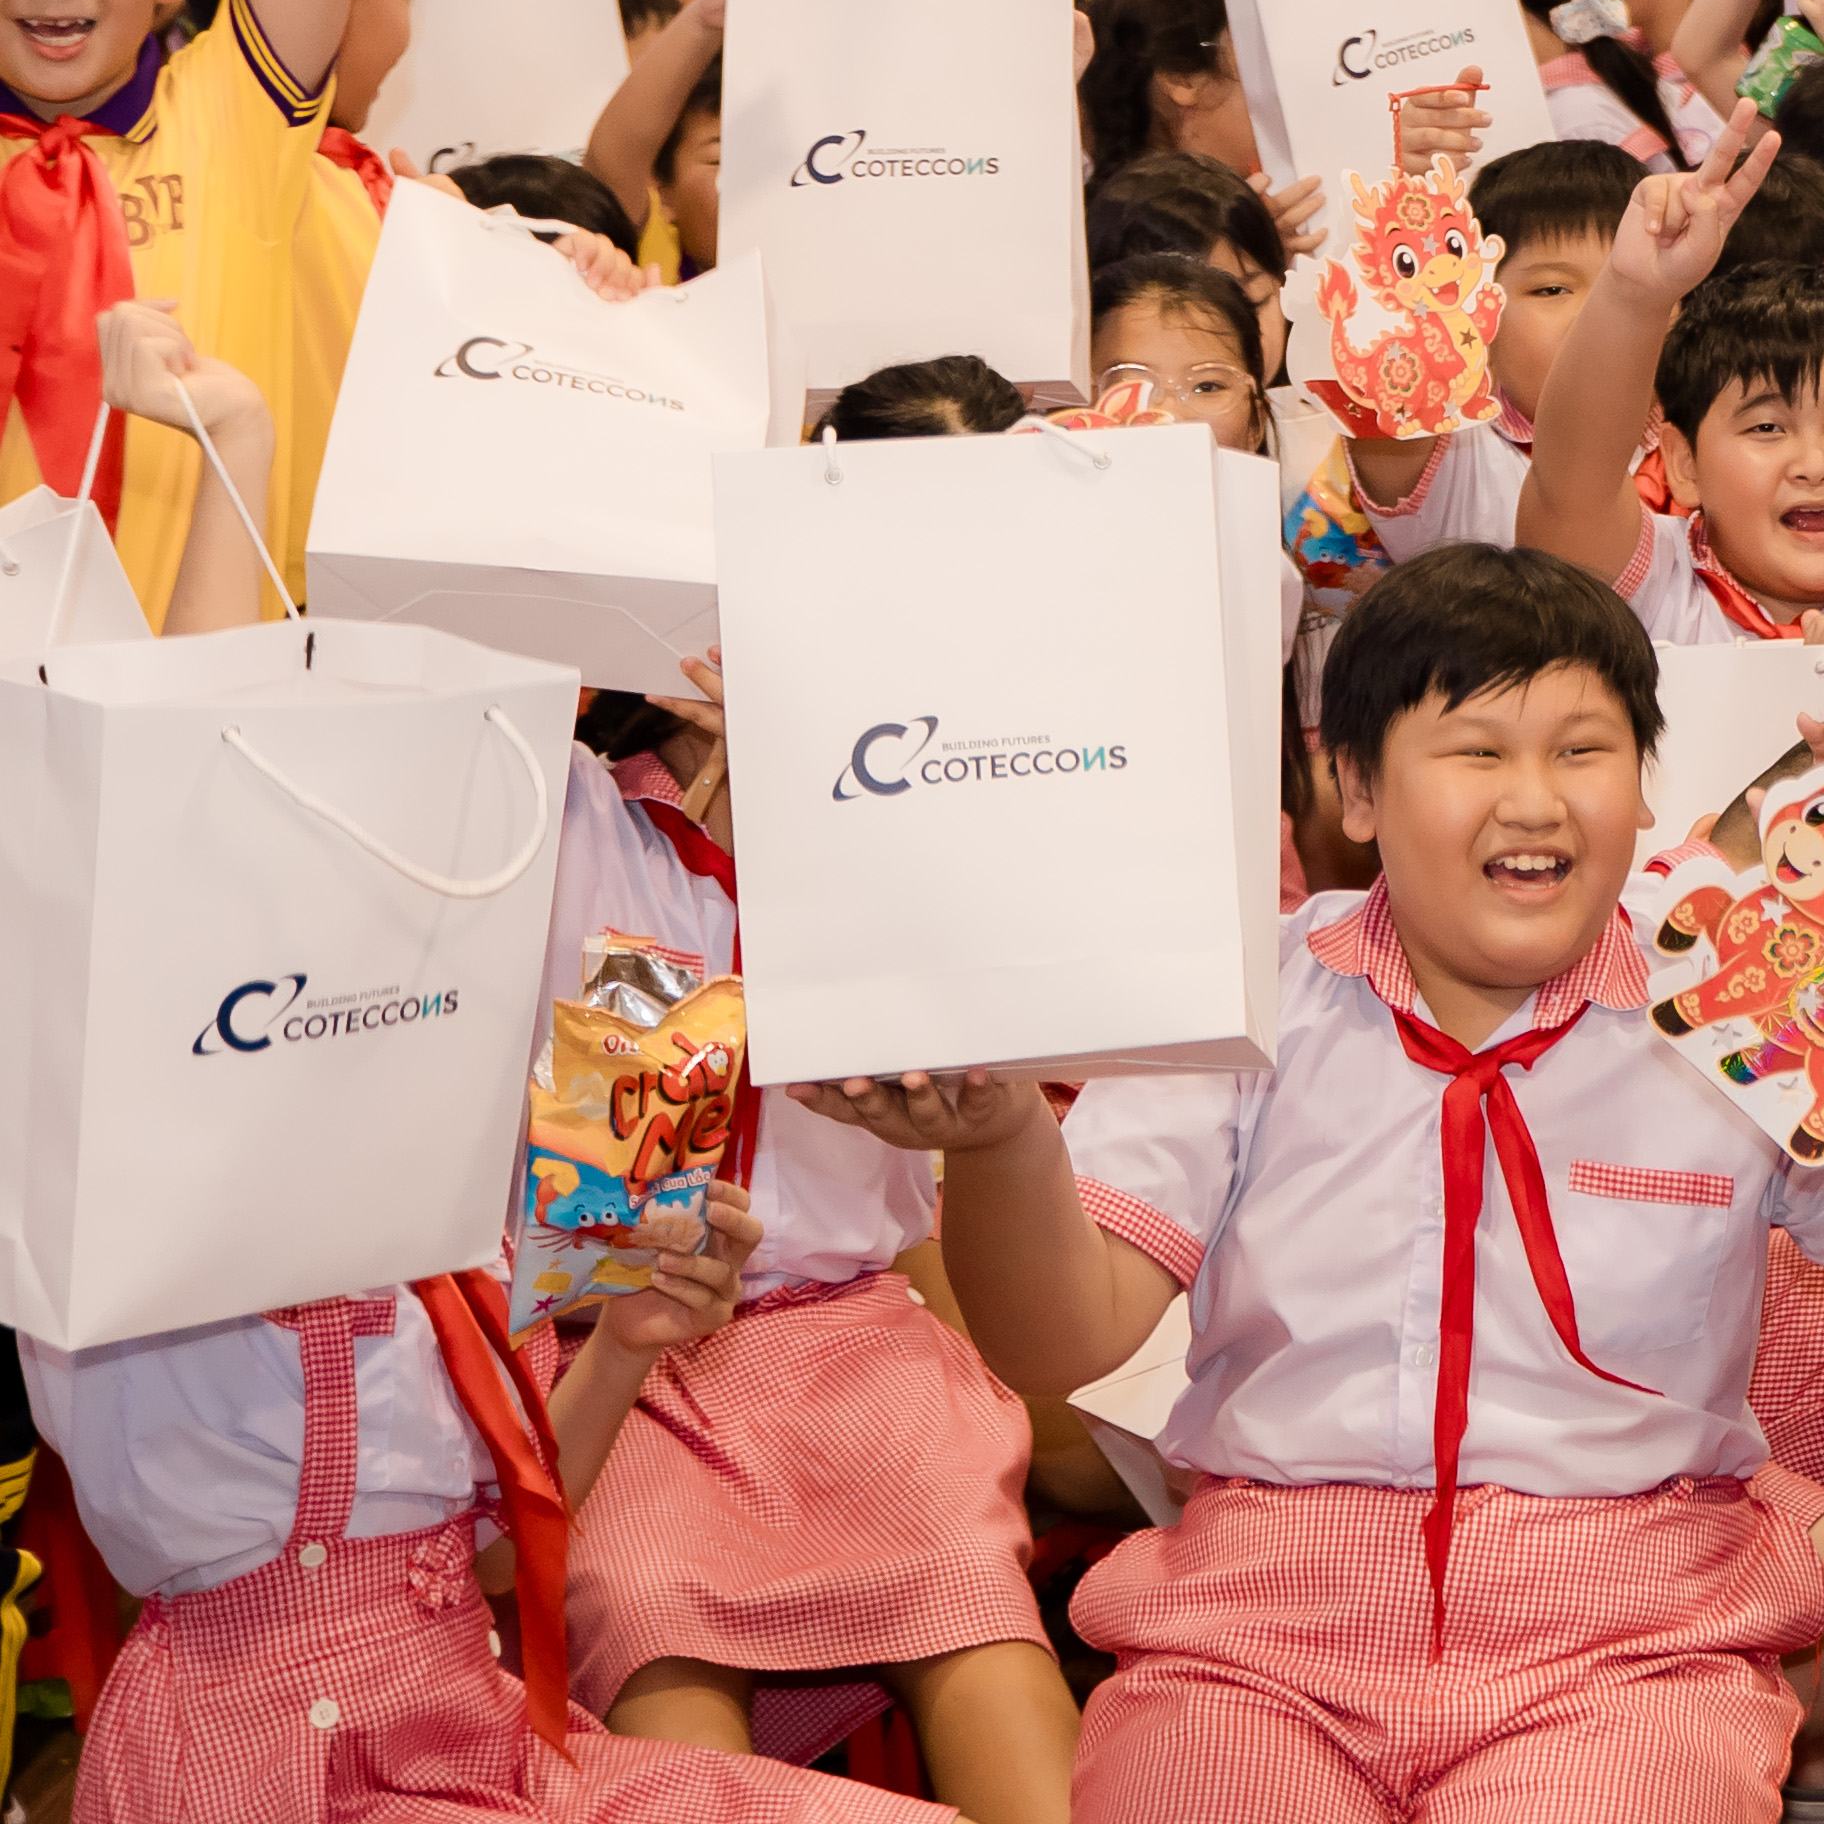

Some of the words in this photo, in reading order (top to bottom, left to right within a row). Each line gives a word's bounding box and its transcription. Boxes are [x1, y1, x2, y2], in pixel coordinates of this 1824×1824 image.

[1375, 28, 1474, 69] COTECCONS
[852, 157, 999, 177] COTECCONS
[512, 365, 685, 411] COTECCONS
[941, 738, 998, 752] BUILDING
[1001, 735, 1051, 748] FUTURES
[920, 745, 1127, 784] COTECCONS
[283, 989, 459, 1043] COTECCONS
[307, 992, 355, 1010] BUILDING
[358, 985, 400, 1002] FUTURES
